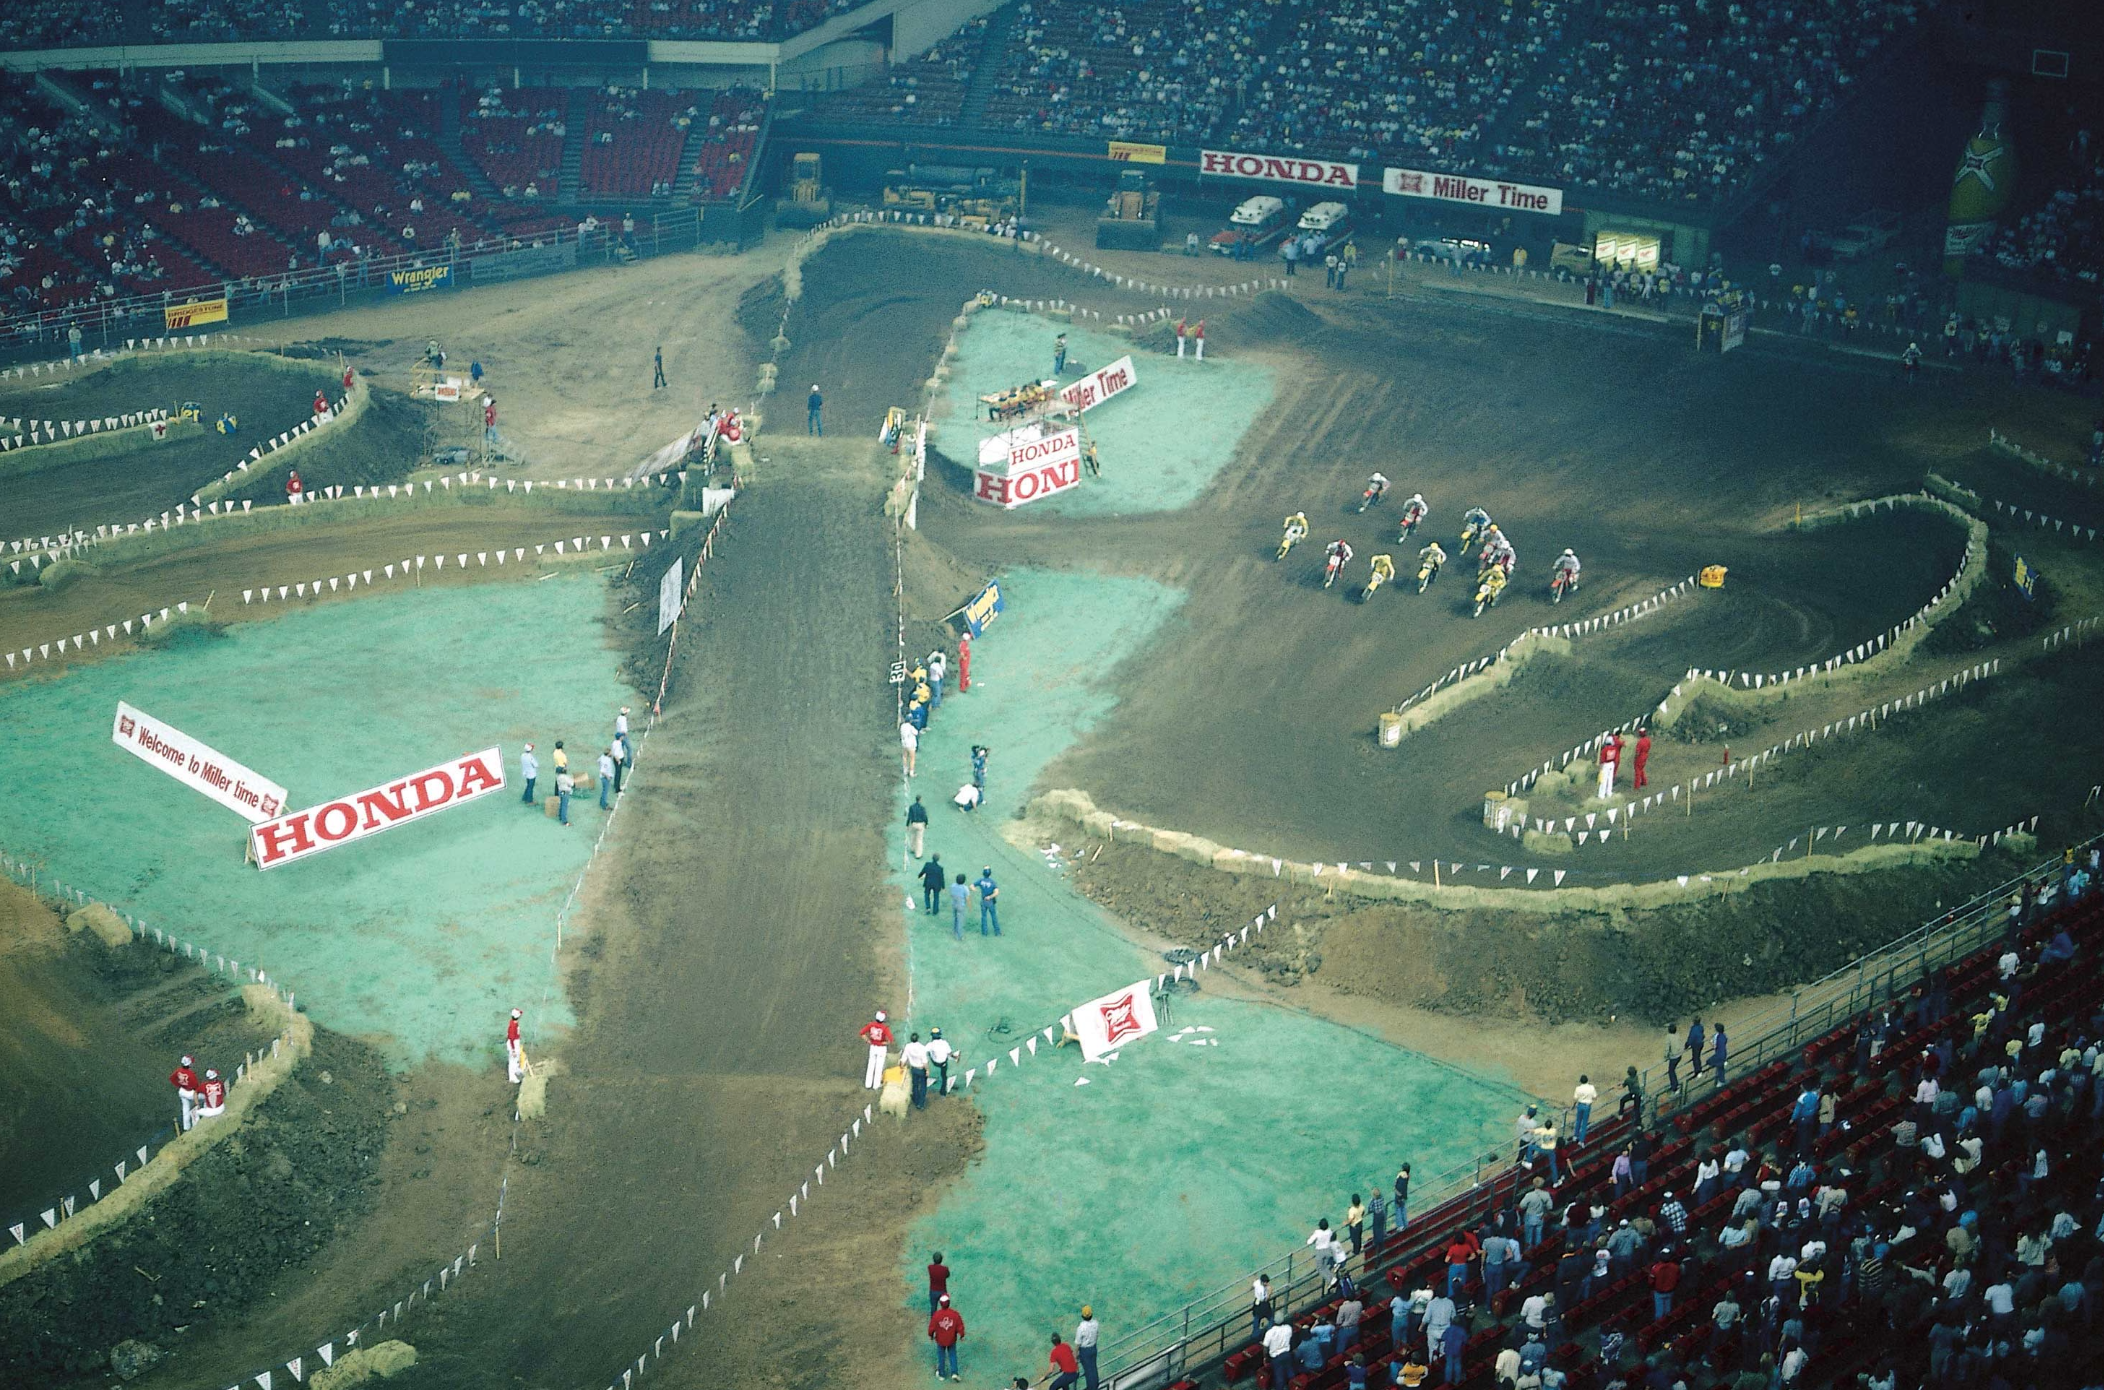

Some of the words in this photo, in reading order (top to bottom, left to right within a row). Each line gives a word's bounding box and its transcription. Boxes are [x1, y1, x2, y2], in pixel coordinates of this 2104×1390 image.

[1203, 153, 1354, 186] HONDA
[1433, 176, 1489, 202] Miller
[1498, 184, 1548, 210] Time
[391, 266, 449, 287] Wrangler
[1097, 368, 1128, 397] Time
[1011, 434, 1076, 466] HONDA
[890, 663, 904, 681] 30
[138, 726, 185, 767] Welcome
[188, 754, 200, 774] to
[200, 761, 233, 793] Miller
[233, 781, 259, 808] time
[256, 758, 502, 863] HONDA
